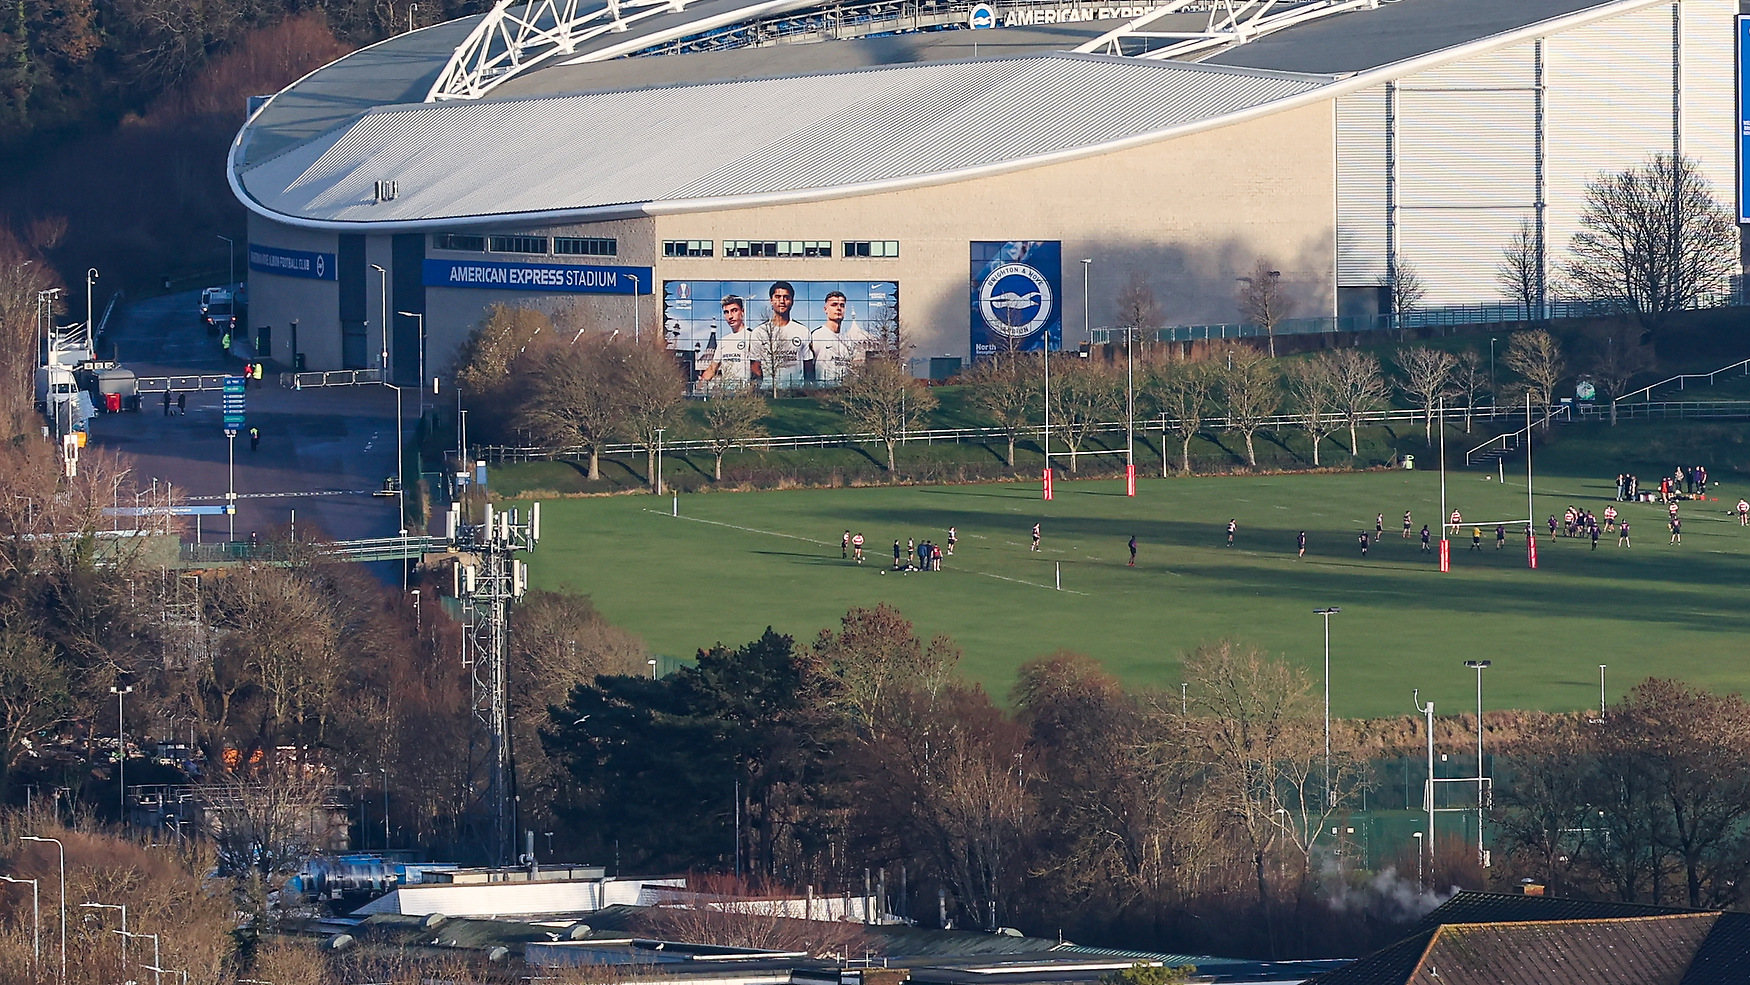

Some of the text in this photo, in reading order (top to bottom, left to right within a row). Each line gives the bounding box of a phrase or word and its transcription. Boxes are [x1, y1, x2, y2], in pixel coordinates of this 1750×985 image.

[1004, 8, 1094, 27] AMERICAN
[450, 266, 617, 287] AMERICAN EXPRESS STADIUM
[988, 267, 1019, 287] BRIGHTON
[1029, 271, 1044, 287] HOVE
[975, 343, 997, 351] North
